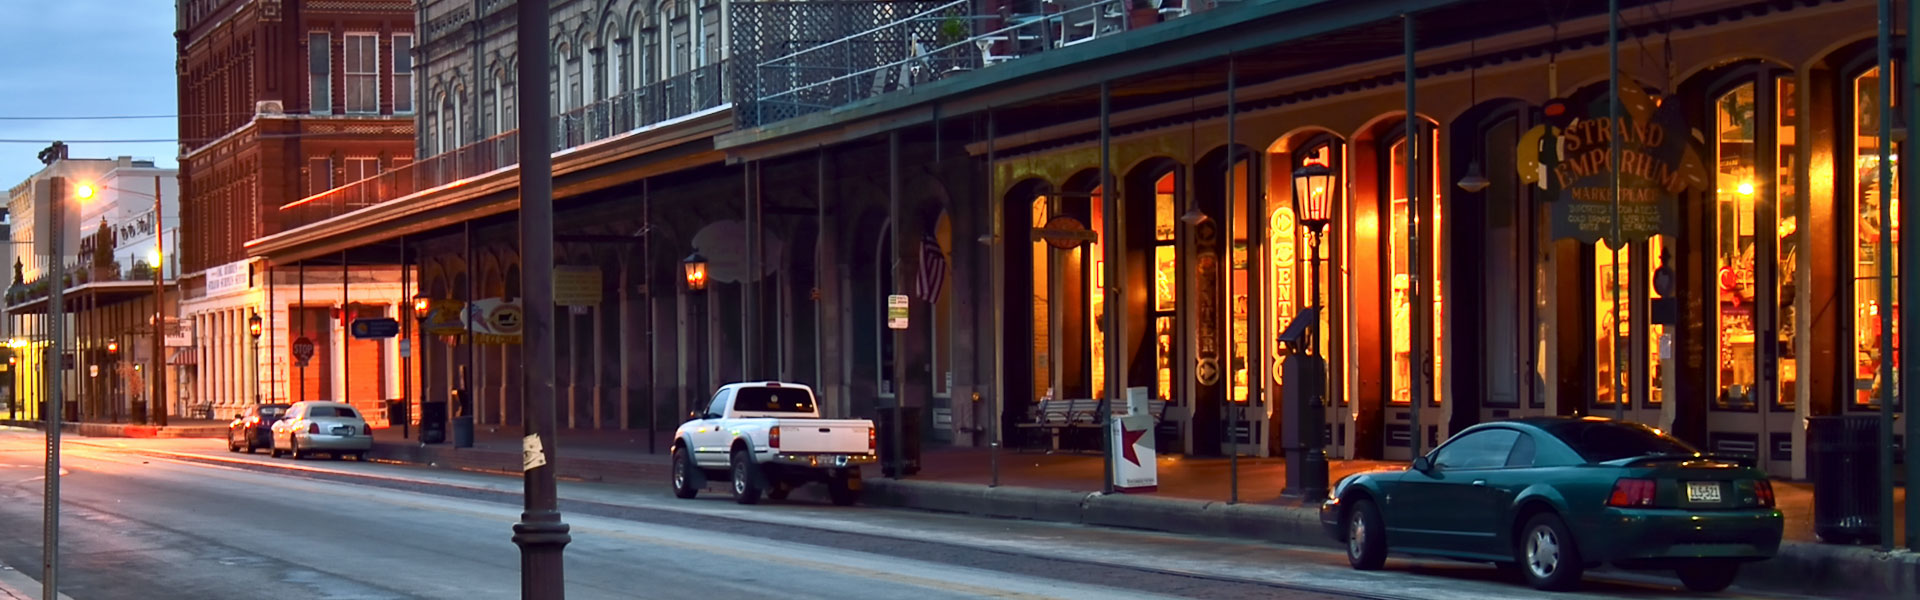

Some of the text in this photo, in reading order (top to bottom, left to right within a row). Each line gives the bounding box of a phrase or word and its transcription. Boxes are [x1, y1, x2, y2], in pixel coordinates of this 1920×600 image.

[1564, 116, 1663, 151] STRAND
[1571, 187, 1659, 201] MARKEPLACE
[1278, 267, 1291, 350] ENTE
[294, 344, 312, 354] STOP
